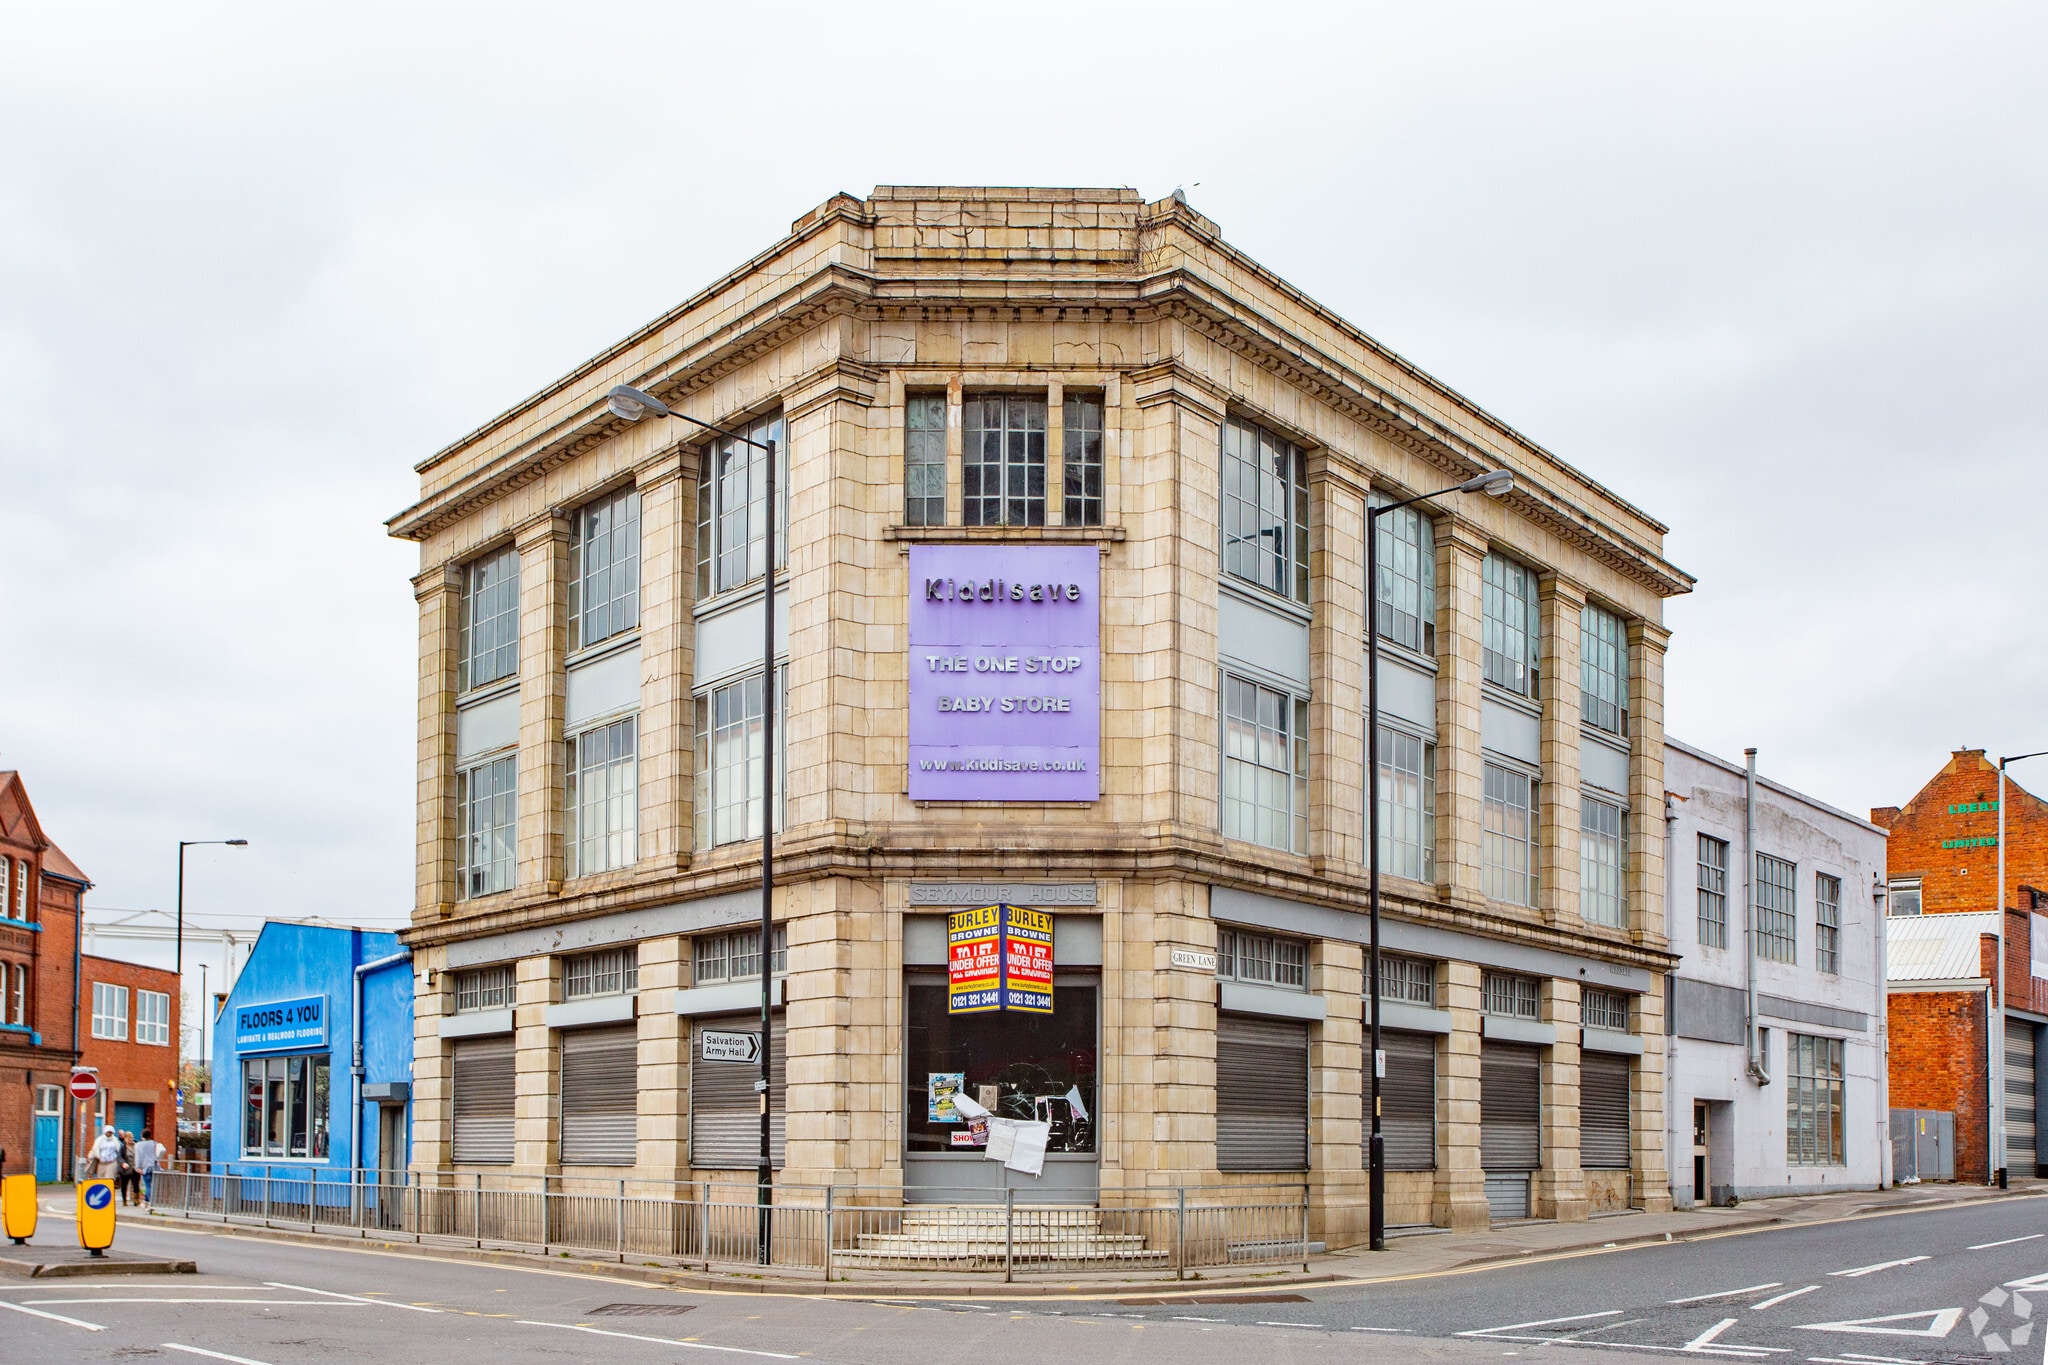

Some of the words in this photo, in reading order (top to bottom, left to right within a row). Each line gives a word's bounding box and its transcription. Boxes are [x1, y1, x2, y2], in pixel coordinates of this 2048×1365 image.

[925, 578, 1081, 601] Kiddisave
[926, 656, 968, 672] THE
[974, 656, 1019, 672] ONE
[1025, 656, 1082, 673] STOP
[937, 696, 994, 712] BABY
[1000, 696, 1071, 712] STORE
[919, 758, 1086, 772] www.kiddisave.co.uk
[1942, 838, 1997, 849] LIMITED
[912, 886, 1013, 901] SEYMOUR
[1029, 886, 1096, 902] HOUSE
[949, 908, 998, 930] BURLEY
[1007, 908, 1052, 930] BURLEY
[950, 927, 998, 941] BROWNE
[1007, 927, 1051, 941] BROWNE
[949, 959, 974, 972] UNDER
[976, 954, 999, 968] OFFER
[1007, 954, 1031, 968] UNDER
[1032, 959, 1053, 972] OFFER
[1173, 953, 1196, 964] GREEN
[1198, 956, 1216, 966] LANE
[952, 996, 967, 1007] 0121
[968, 994, 980, 1006] 321
[981, 992, 999, 1004] 3441
[1008, 992, 1023, 1004] 0121
[1024, 994, 1036, 1006] 321
[1036, 996, 1051, 1008] 3441
[241, 1010, 283, 1029] FLOORS
[286, 1009, 293, 1024] 4
[297, 1005, 319, 1023] YOU
[237, 1034, 261, 1044] LAMINATE
[267, 1031, 295, 1041] REALWOOD
[296, 1027, 323, 1038] FLOORING
[706, 1036, 745, 1046] Salvation
[705, 1047, 727, 1057] Army
[728, 1048, 745, 1056] Hall
